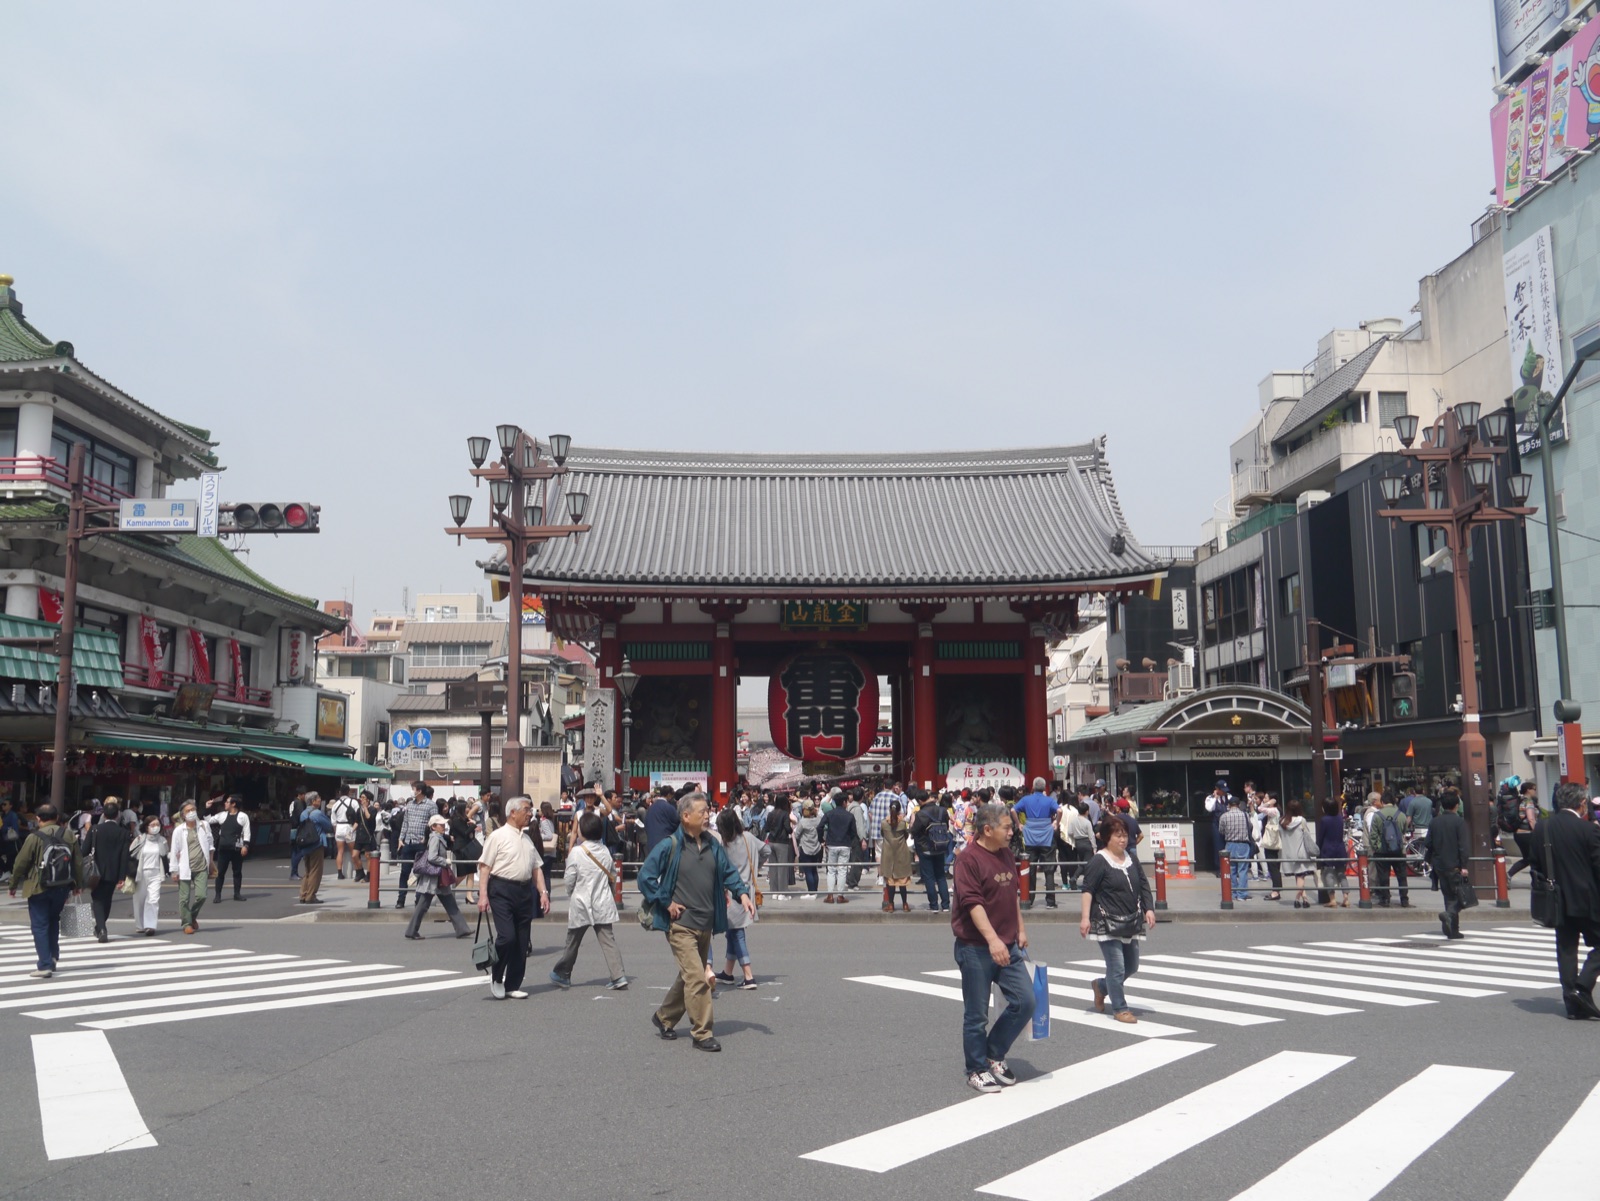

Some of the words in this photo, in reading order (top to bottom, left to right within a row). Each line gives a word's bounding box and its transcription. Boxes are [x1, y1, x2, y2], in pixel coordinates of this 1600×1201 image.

[133, 503, 184, 517] 雷門
[203, 475, 215, 534] スクランブル式
[126, 519, 170, 527] Kaminarimon
[173, 519, 189, 527] Gate
[780, 651, 866, 759] 雷門
[1233, 734, 1280, 745] 雷門交番
[964, 767, 1011, 778] 花まつり
